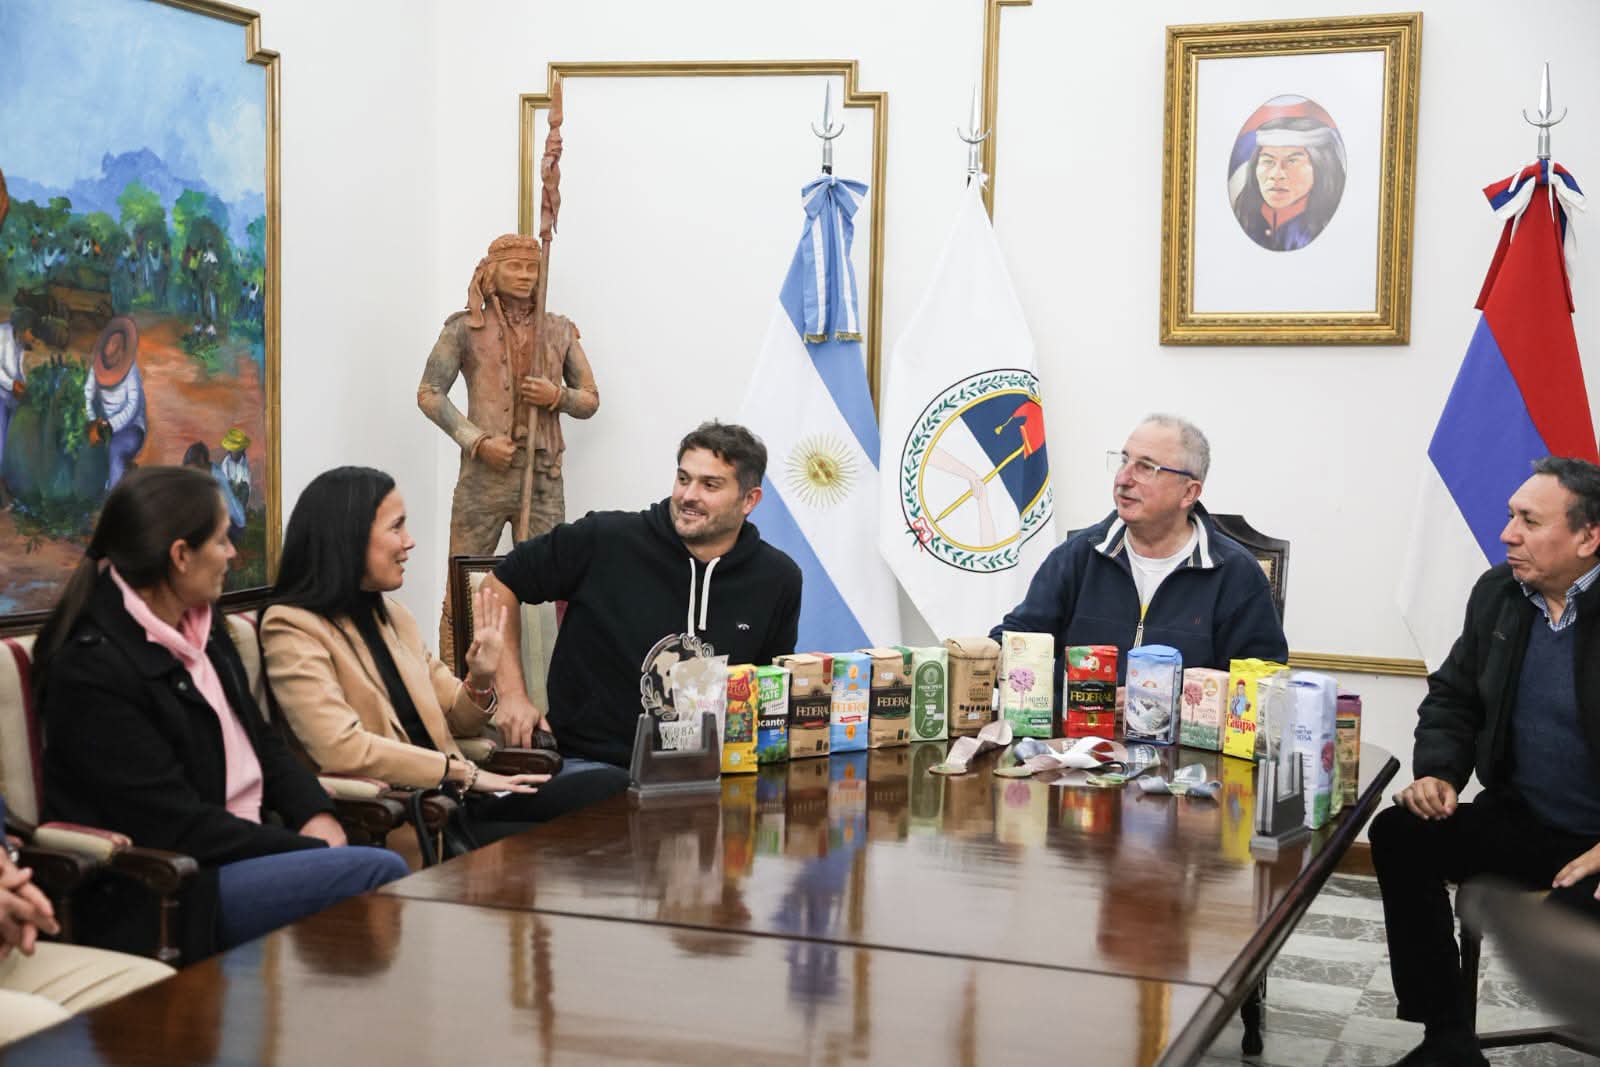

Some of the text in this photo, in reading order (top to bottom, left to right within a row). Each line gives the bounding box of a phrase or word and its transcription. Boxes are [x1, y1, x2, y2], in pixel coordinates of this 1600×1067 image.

[877, 695, 910, 708] FEDERAL
[1070, 690, 1114, 702] FEDERAL
[796, 704, 830, 718] FEDERAL
